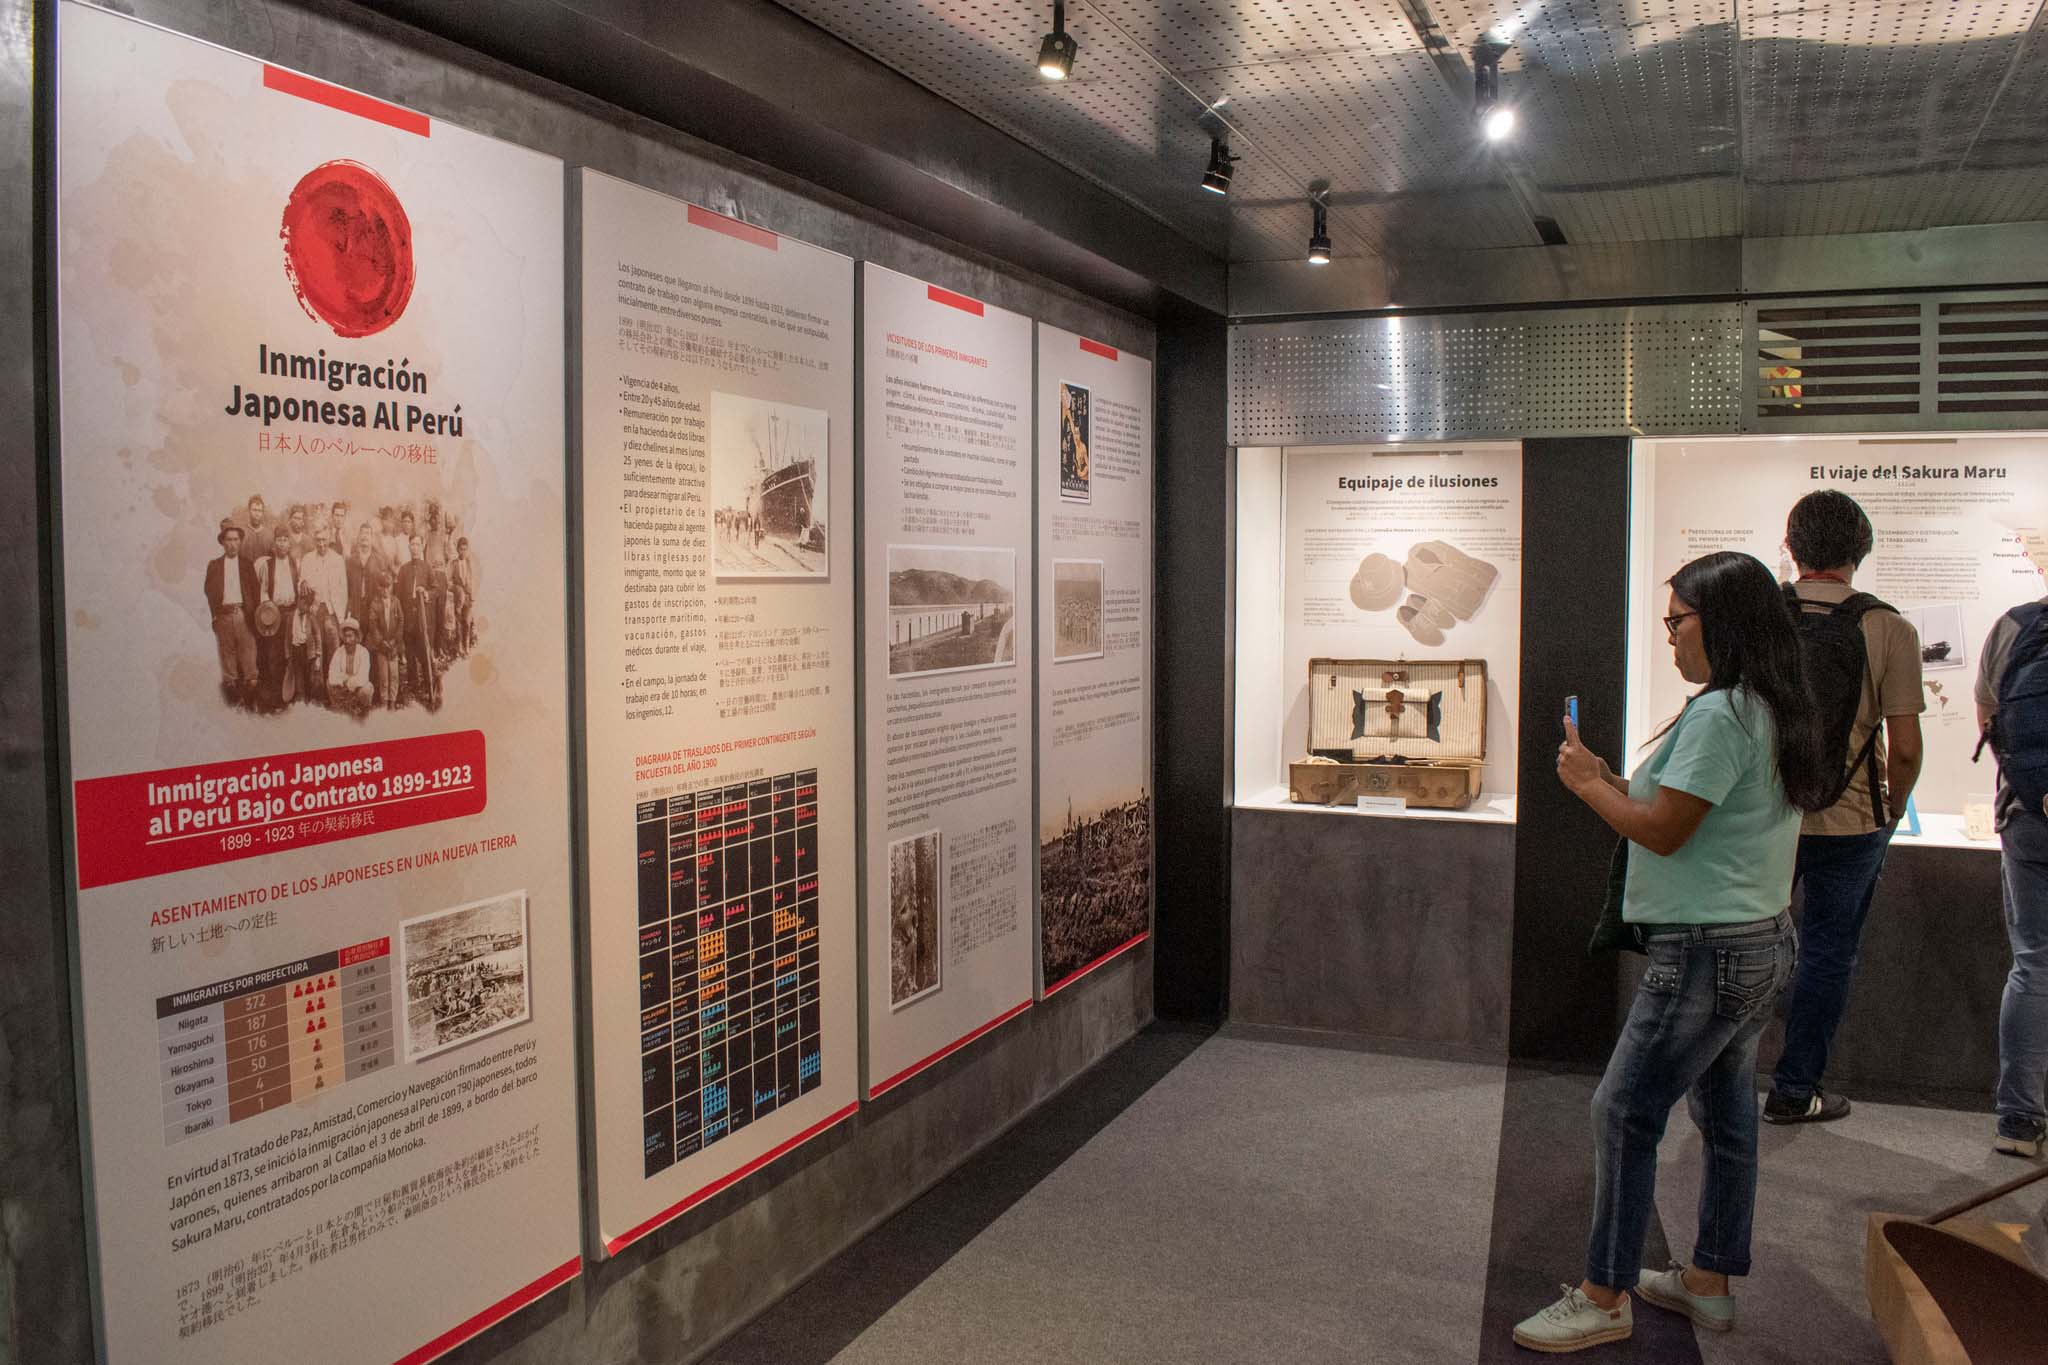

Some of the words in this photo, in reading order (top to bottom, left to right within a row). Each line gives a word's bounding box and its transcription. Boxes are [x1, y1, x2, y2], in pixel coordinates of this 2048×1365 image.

[260, 344, 427, 394] Inmigración
[623, 376, 650, 390] Vigencia
[651, 380, 658, 389] de
[664, 382, 680, 394] años.
[225, 385, 366, 427] Japonesa
[373, 402, 400, 431] Al
[407, 404, 462, 437] Perú
[258, 432, 438, 464] 日本人のペルーへの移住
[1338, 475, 1403, 492] Equipaje
[1407, 475, 1425, 488] de
[1429, 474, 1498, 488] ilusiones
[1810, 465, 1825, 480] El
[1829, 465, 1868, 482] viaje
[1872, 465, 1897, 480] del
[1901, 465, 1959, 480] Sakura
[1964, 465, 2006, 480] Maru
[624, 551, 650, 562] libras
[654, 551, 689, 564] inglesas
[624, 583, 657, 593] destinaba
[659, 584, 674, 594] para
[676, 583, 694, 592] cubrir
[697, 582, 706, 592] los
[624, 598, 650, 612] gastos
[652, 598, 662, 608] de
[624, 614, 667, 626] transporte
[680, 628, 706, 640] gastos
[636, 751, 672, 768] DIAGRAMA
[673, 750, 682, 761] DE
[684, 745, 721, 760] TRASLADOS
[722, 742, 734, 753] DEL
[734, 739, 757, 751] PRIMER
[758, 731, 797, 747] CONTINGENTE
[798, 728, 816, 740] SEGÚN
[148, 762, 284, 806] Inmigración
[290, 754, 384, 785] Japonesa
[636, 766, 672, 782] ENCUESTA
[673, 763, 686, 775] DEL
[687, 759, 701, 771] AÑO
[703, 758, 718, 770] 1900
[149, 810, 171, 836] al
[178, 794, 231, 832] Perú
[238, 789, 285, 823] Bajo
[290, 782, 376, 813] Contrato
[382, 765, 472, 798] 1899-1923
[220, 832, 252, 852] 1899
[265, 825, 295, 845] 1923
[299, 810, 375, 835] 年の契約移民
[150, 889, 268, 928] ASENTAMIENTO
[270, 884, 289, 902] DE
[293, 877, 318, 897] LOS
[321, 860, 394, 890] JAPONESES
[396, 856, 412, 874] EN
[415, 851, 440, 871] UNA
[442, 843, 478, 865] NUEVA
[481, 834, 518, 857] TIERRA
[151, 911, 278, 955] 新しい土地への定住
[173, 979, 234, 1007] INMIGRANTES
[236, 974, 254, 990] POR
[255, 962, 309, 985] PREFECTURA
[178, 1014, 208, 1031] Niigata
[246, 1014, 267, 1031] 187
[167, 1035, 215, 1056] Yamaguchi
[248, 1035, 267, 1052] 176
[170, 1056, 214, 1077] Hiroshima
[251, 1055, 267, 1072] 50
[174, 1077, 215, 1096] Okayama
[256, 1078, 264, 1091] 4
[168, 1172, 182, 1187] En
[184, 1156, 218, 1181] virtud
[220, 1151, 230, 1167] al
[232, 1138, 274, 1163] Tratado
[276, 1132, 288, 1146] de
[290, 1126, 311, 1140] Paz,
[313, 1105, 356, 1132] Amistad,
[357, 1089, 401, 1115] Comercio
[402, 1088, 407, 1100] y
[408, 1068, 458, 1095] Navegación
[459, 1055, 491, 1075] firmado
[492, 1048, 512, 1063] entre
[514, 1039, 530, 1054] Perú
[531, 1039, 536, 1050] y
[186, 1097, 212, 1114] Tokyo
[258, 1098, 264, 1110] 1
[170, 1187, 206, 1210] Japón
[208, 1182, 221, 1195] en
[224, 1167, 253, 1189] 1873,
[255, 1164, 266, 1177] se
[268, 1149, 295, 1171] inició
[298, 1147, 306, 1160] la
[309, 1124, 366, 1155] inmigración
[368, 1109, 409, 1135] japonesa
[411, 1102, 418, 1115] al
[420, 1094, 439, 1111] Perú
[441, 1091, 456, 1103] con
[457, 1081, 472, 1097] 790
[472, 1069, 513, 1093] japoneses,
[516, 1059, 537, 1074] todos
[184, 1117, 214, 1136] Ibaraki
[170, 1205, 219, 1232] varones,
[224, 1184, 267, 1213] quienes
[272, 1163, 319, 1190] arribaron
[323, 1154, 332, 1169] al
[335, 1143, 365, 1163] Callao
[369, 1135, 377, 1149] el
[381, 1132, 386, 1144] 3
[390, 1128, 401, 1141] de
[405, 1116, 425, 1134] abril
[428, 1112, 438, 1125] de
[442, 1101, 464, 1119] 1899,
[467, 1099, 472, 1108] a
[475, 1088, 499, 1105] bordo
[502, 1079, 514, 1094] del
[516, 1073, 537, 1088] barco
[172, 1227, 211, 1252] Sakura
[214, 1214, 245, 1234] Maru,
[247, 1186, 310, 1220] contratados
[312, 1178, 328, 1196] por
[330, 1173, 338, 1185] la
[340, 1153, 386, 1181] compañía
[388, 1138, 426, 1161] Morioka.
